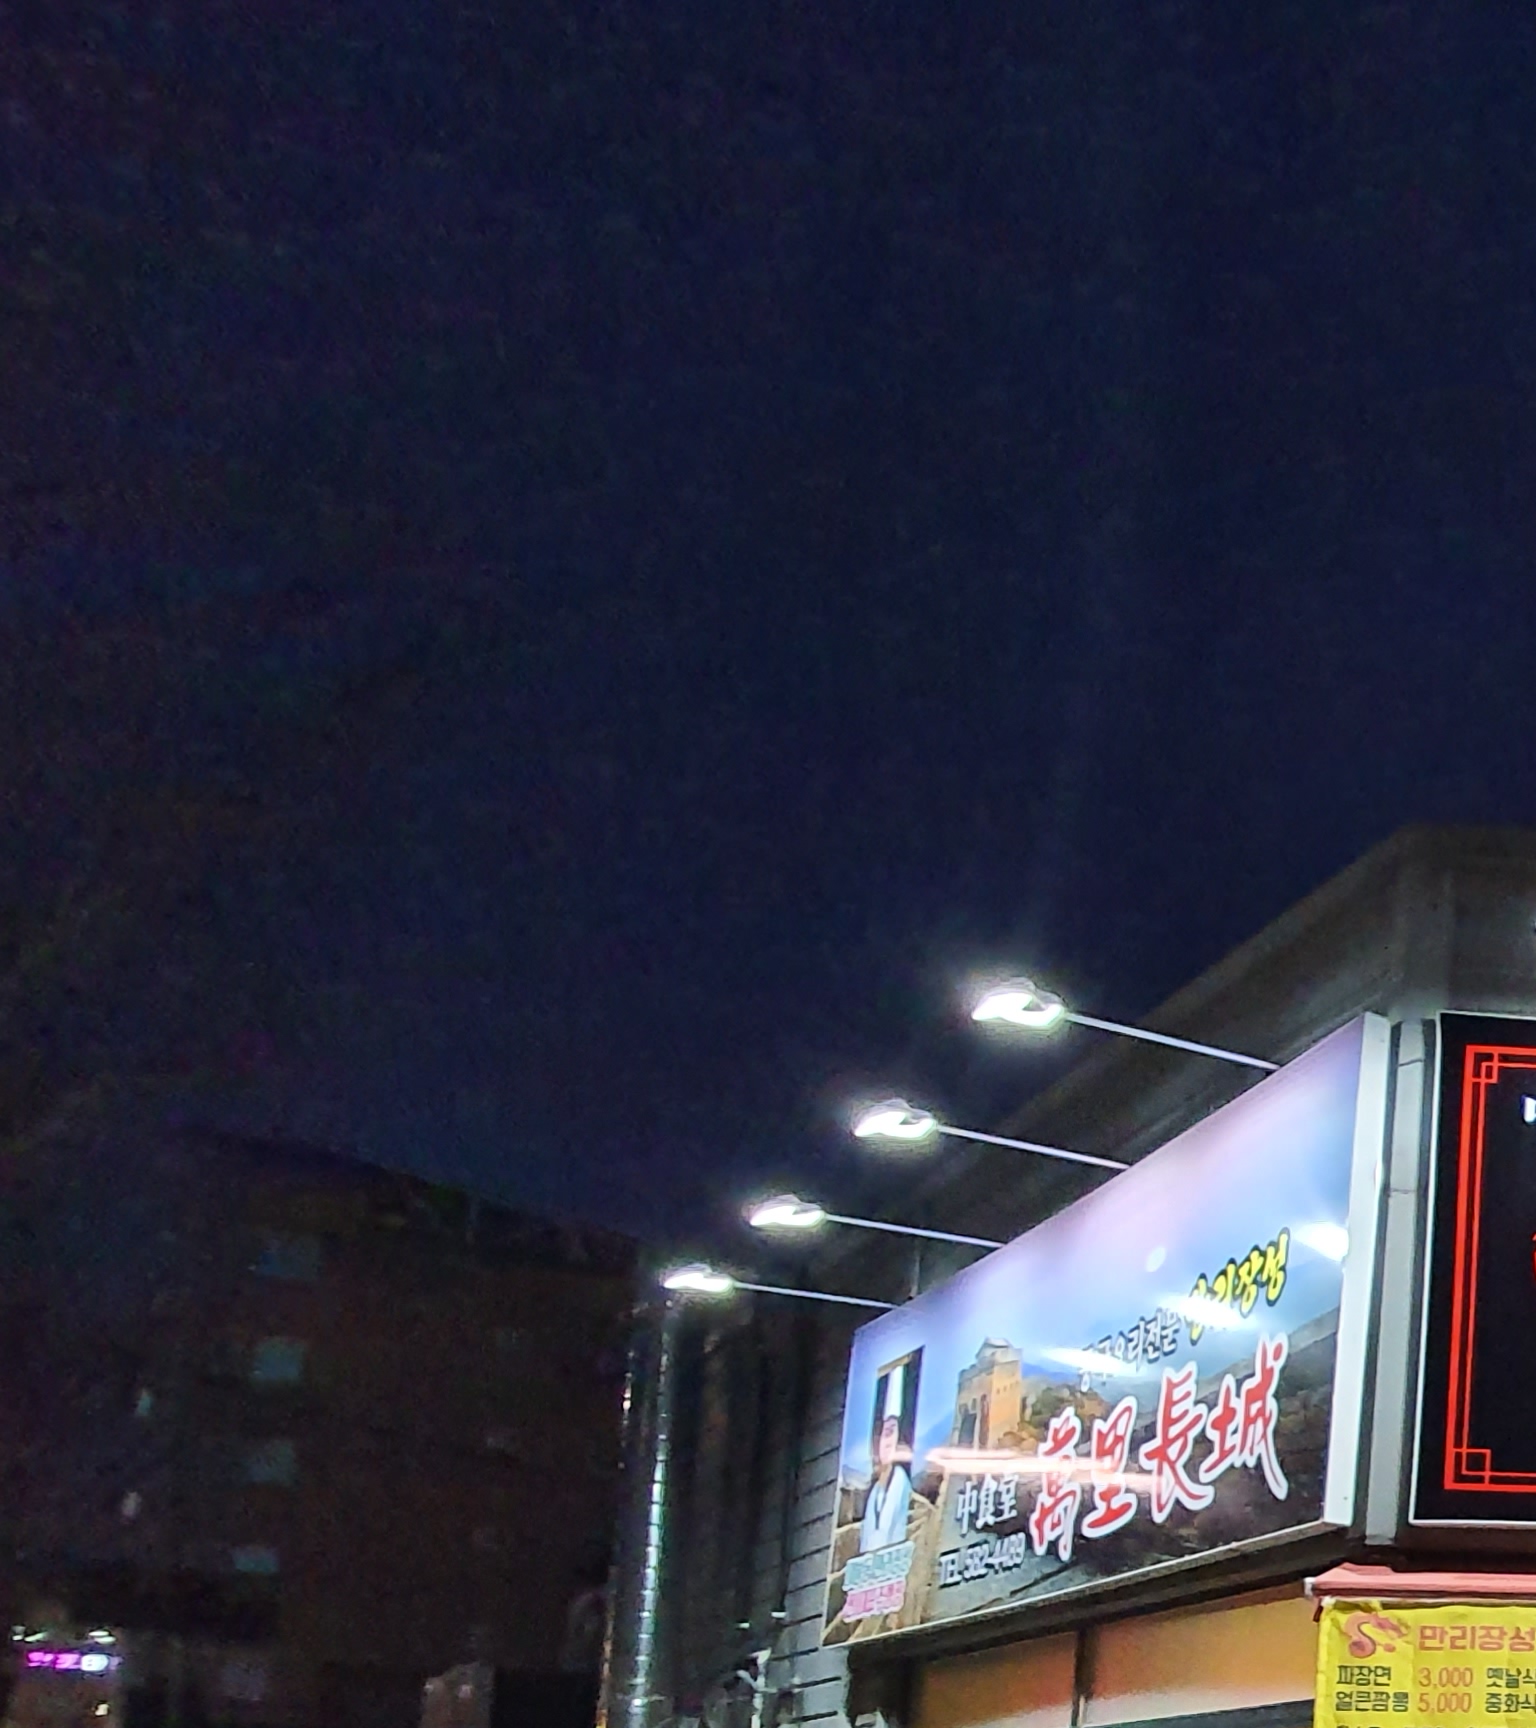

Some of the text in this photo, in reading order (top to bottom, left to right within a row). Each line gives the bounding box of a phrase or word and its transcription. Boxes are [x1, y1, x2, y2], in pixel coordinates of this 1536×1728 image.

[1028, 1333, 1292, 1563] 萬里長城
[1418, 1625, 1536, 1652] 만리장성
[1418, 1667, 1473, 1689] 3,000
[1335, 1690, 1409, 1712] 얼큰짬뽕
[1417, 1692, 1473, 1714] 5,000
